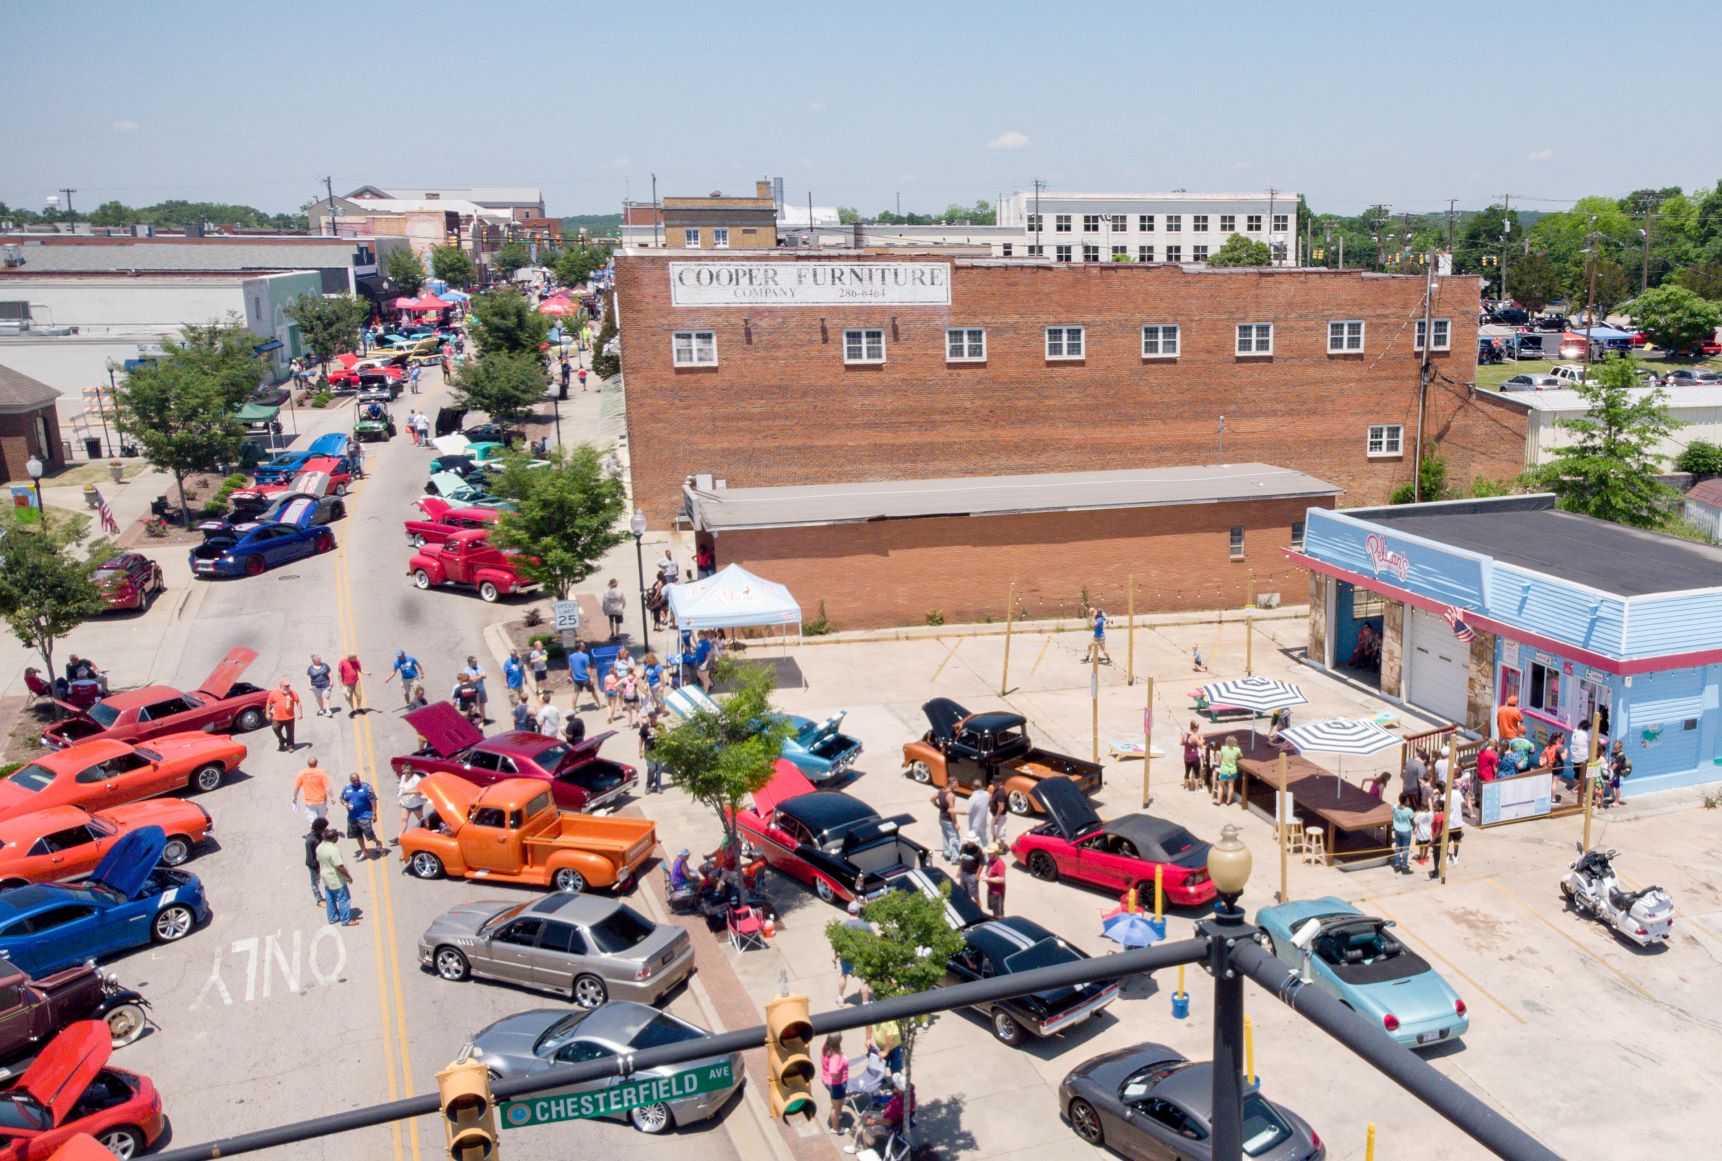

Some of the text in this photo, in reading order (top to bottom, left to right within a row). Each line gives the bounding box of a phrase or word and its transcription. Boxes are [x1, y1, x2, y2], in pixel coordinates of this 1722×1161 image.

[678, 267, 943, 287] COOPER FURNITURE
[733, 287, 797, 298] COMPANY
[558, 615, 577, 626] 25
[188, 925, 347, 1011] ONLY
[535, 1066, 730, 1121] CHESTERFIELD AVE
